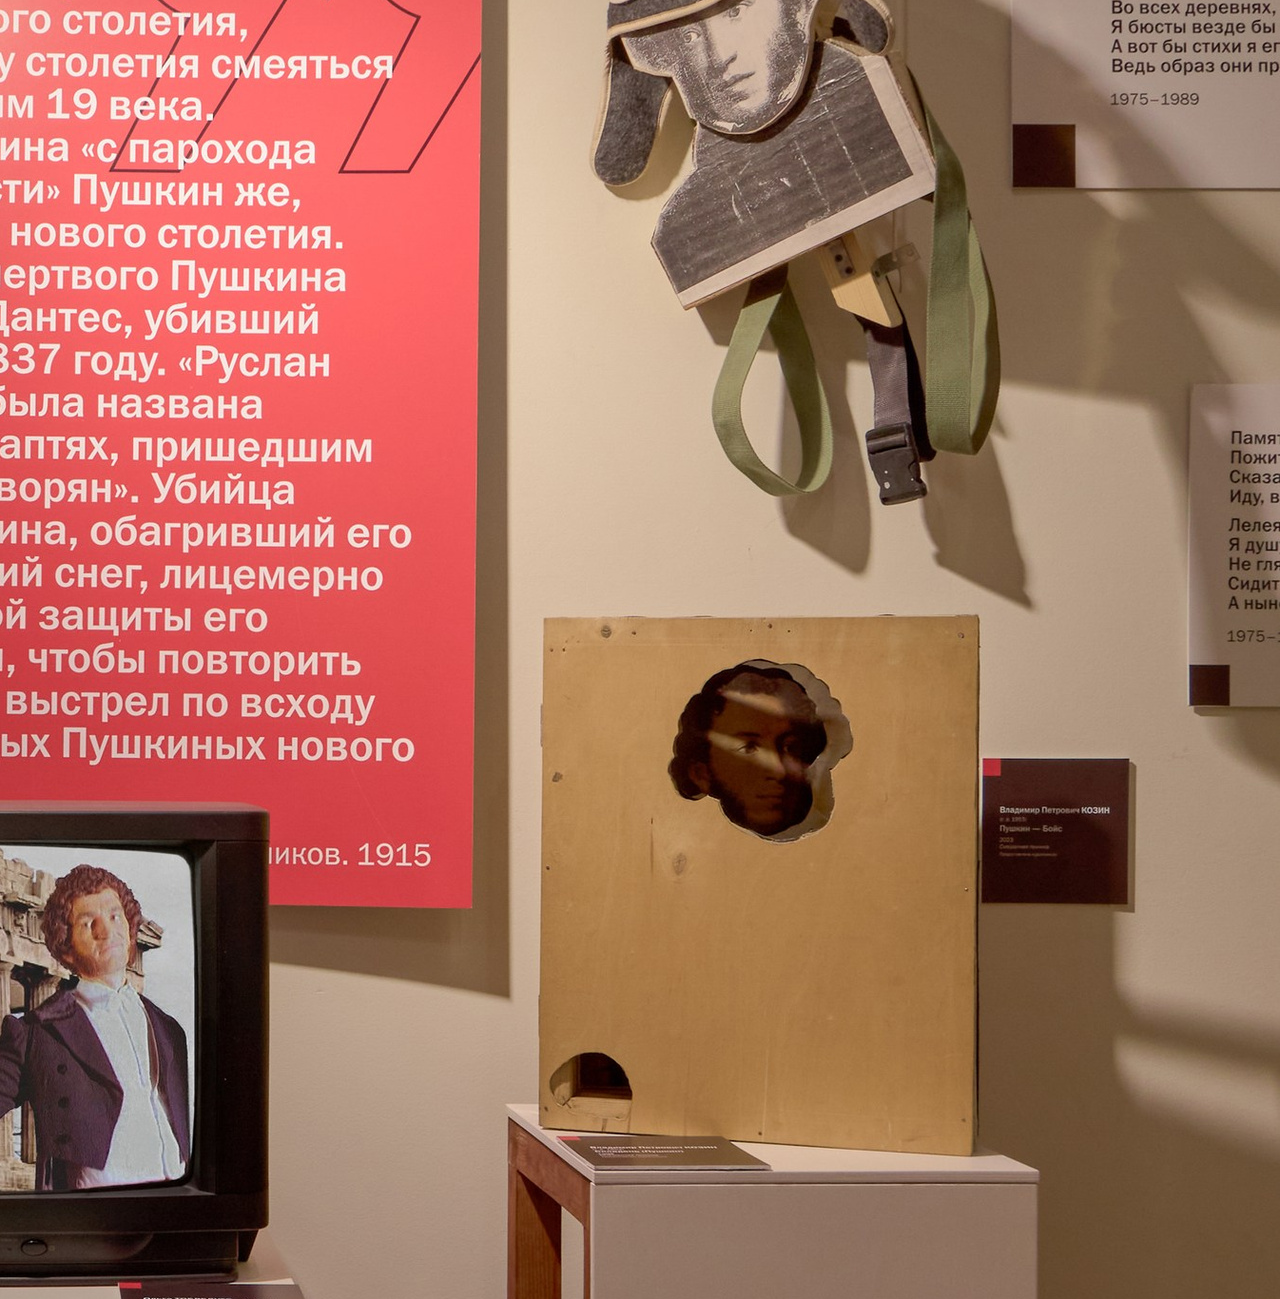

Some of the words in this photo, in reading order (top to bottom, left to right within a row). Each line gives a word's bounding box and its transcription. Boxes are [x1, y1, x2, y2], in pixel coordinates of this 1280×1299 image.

[1112, 0, 1134, 14] Во
[1139, 3, 1180, 14] всех
[1185, 3, 1276, 17] деревнях,
[1111, 19, 1122, 34] Я
[1128, 19, 1186, 34] бюсты
[1192, 22, 1246, 36] везде
[1251, 19, 1275, 34] бы
[26, 52, 199, 78] столетия
[211, 55, 393, 79] смеяться
[1112, 58, 1156, 76] Ведь
[1161, 58, 1215, 76] образ
[1220, 61, 1252, 73] они
[47, 88, 97, 120] 19
[110, 96, 213, 121] века.
[81, 138, 117, 163] «с
[129, 138, 316, 170] парохода
[73, 173, 223, 213] Пушкин
[234, 182, 300, 213] же,
[171, 259, 346, 299] Пушкина
[144, 302, 319, 341] убивший
[74, 351, 166, 383] году.
[179, 345, 330, 384] «Руслан
[132, 437, 372, 468] пришедшим
[90, 514, 334, 553] обагривший
[347, 524, 412, 549] его
[55, 563, 148, 595] снег,
[160, 565, 383, 597] лицемерно
[28, 642, 145, 674] чтобы
[159, 650, 361, 682] повторить
[6, 691, 169, 723] выстрел
[183, 693, 228, 718] по
[241, 693, 376, 726] всходу
[63, 726, 266, 766] Пушкиных
[278, 736, 415, 762] нового
[999, 806, 1040, 814] Владимир
[1041, 806, 1080, 815] Петрович
[1081, 806, 1110, 814] КОЗИН
[999, 824, 1031, 834] Пушкин
[269, 846, 348, 865] иков.
[358, 843, 431, 867] 1915
